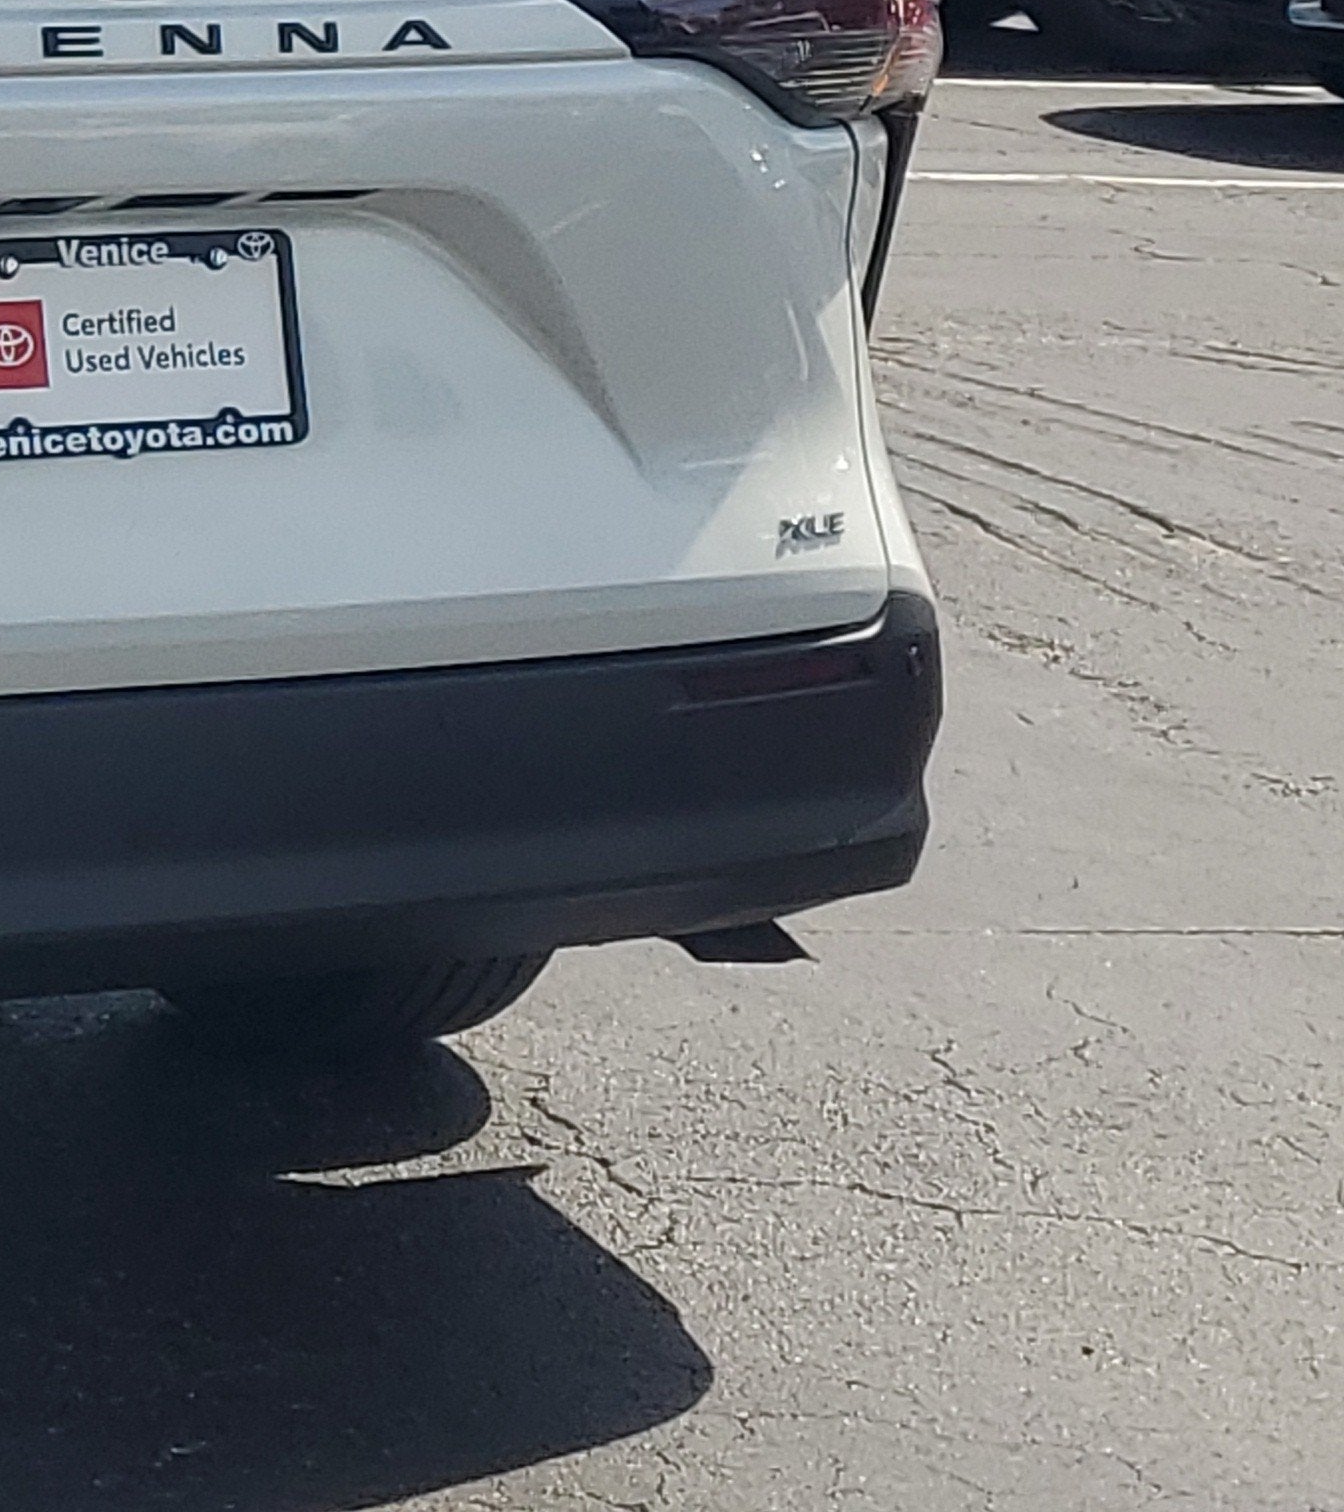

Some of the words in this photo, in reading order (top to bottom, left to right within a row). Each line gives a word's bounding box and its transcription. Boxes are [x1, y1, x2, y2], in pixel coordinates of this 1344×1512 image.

[57, 237, 169, 268] Venice
[62, 307, 176, 337] Certified
[65, 347, 131, 374] Used
[137, 342, 246, 370] Vehicles
